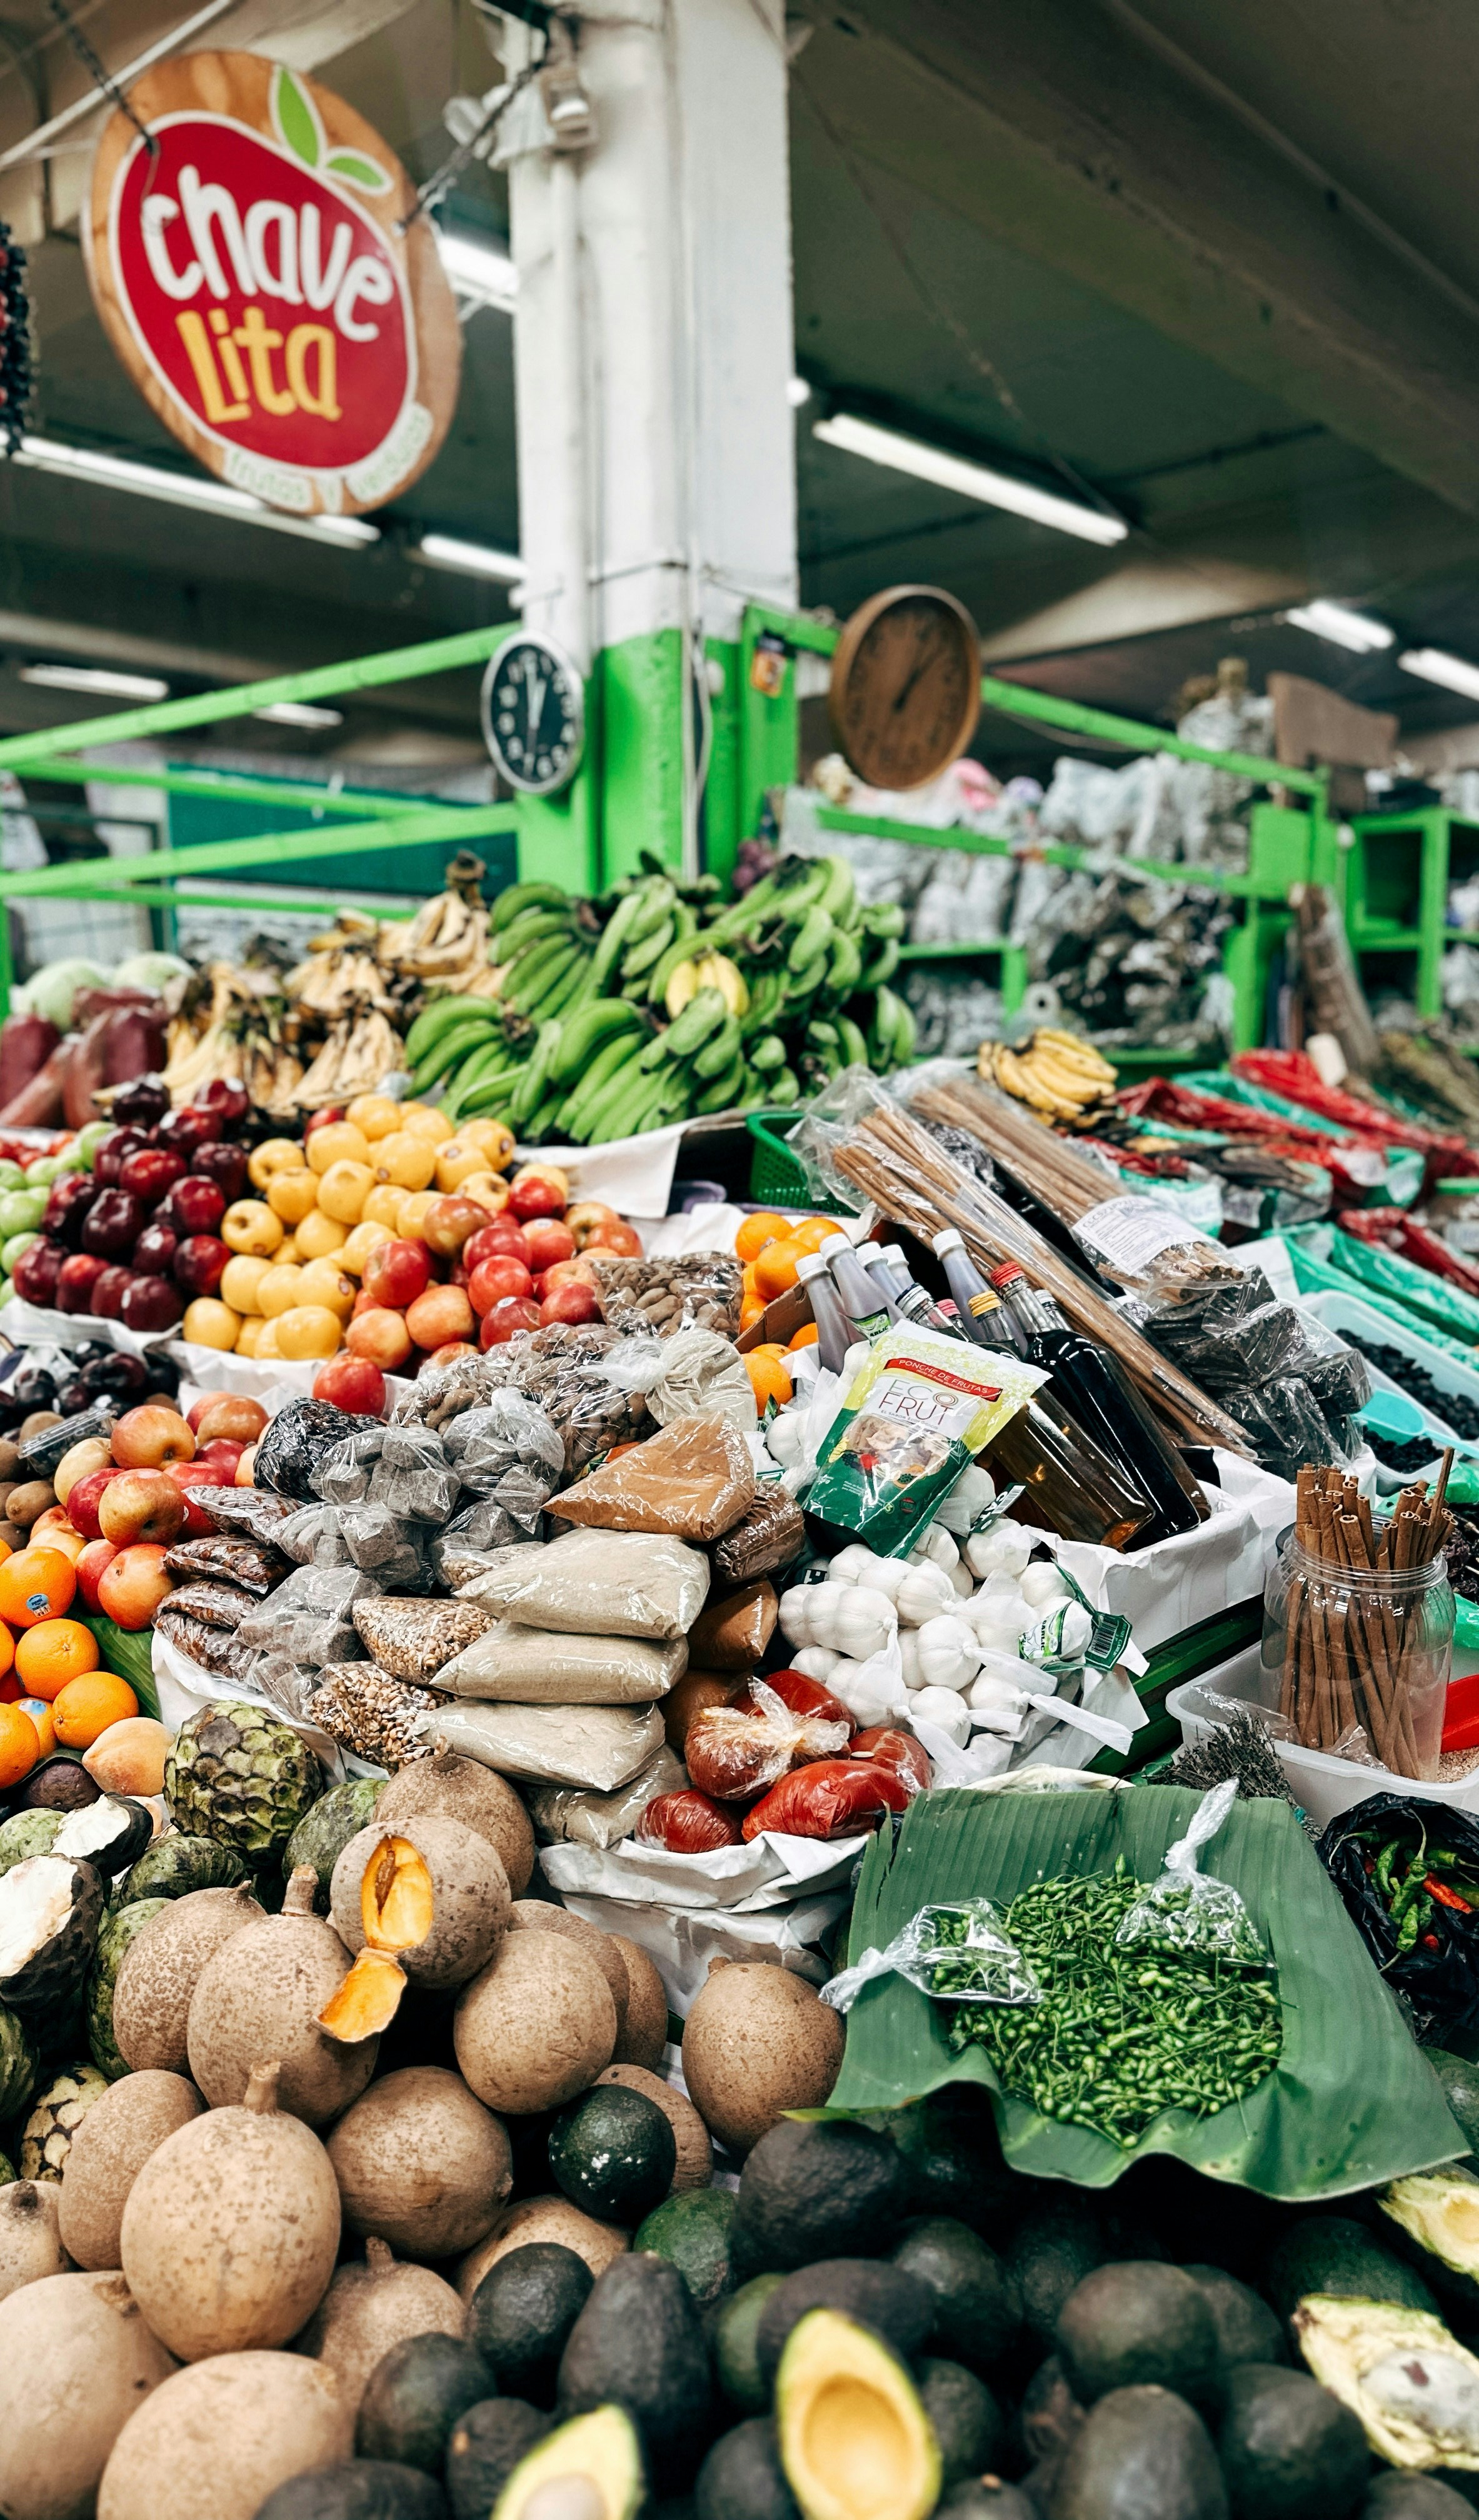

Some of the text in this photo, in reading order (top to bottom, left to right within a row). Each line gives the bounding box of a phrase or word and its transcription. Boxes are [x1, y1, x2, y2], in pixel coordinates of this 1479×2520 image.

[888, 1379, 958, 1407] ECO
[898, 1360, 988, 1394] PONCHE DE FRUTAS
[878, 1392, 954, 1425] FRUT
